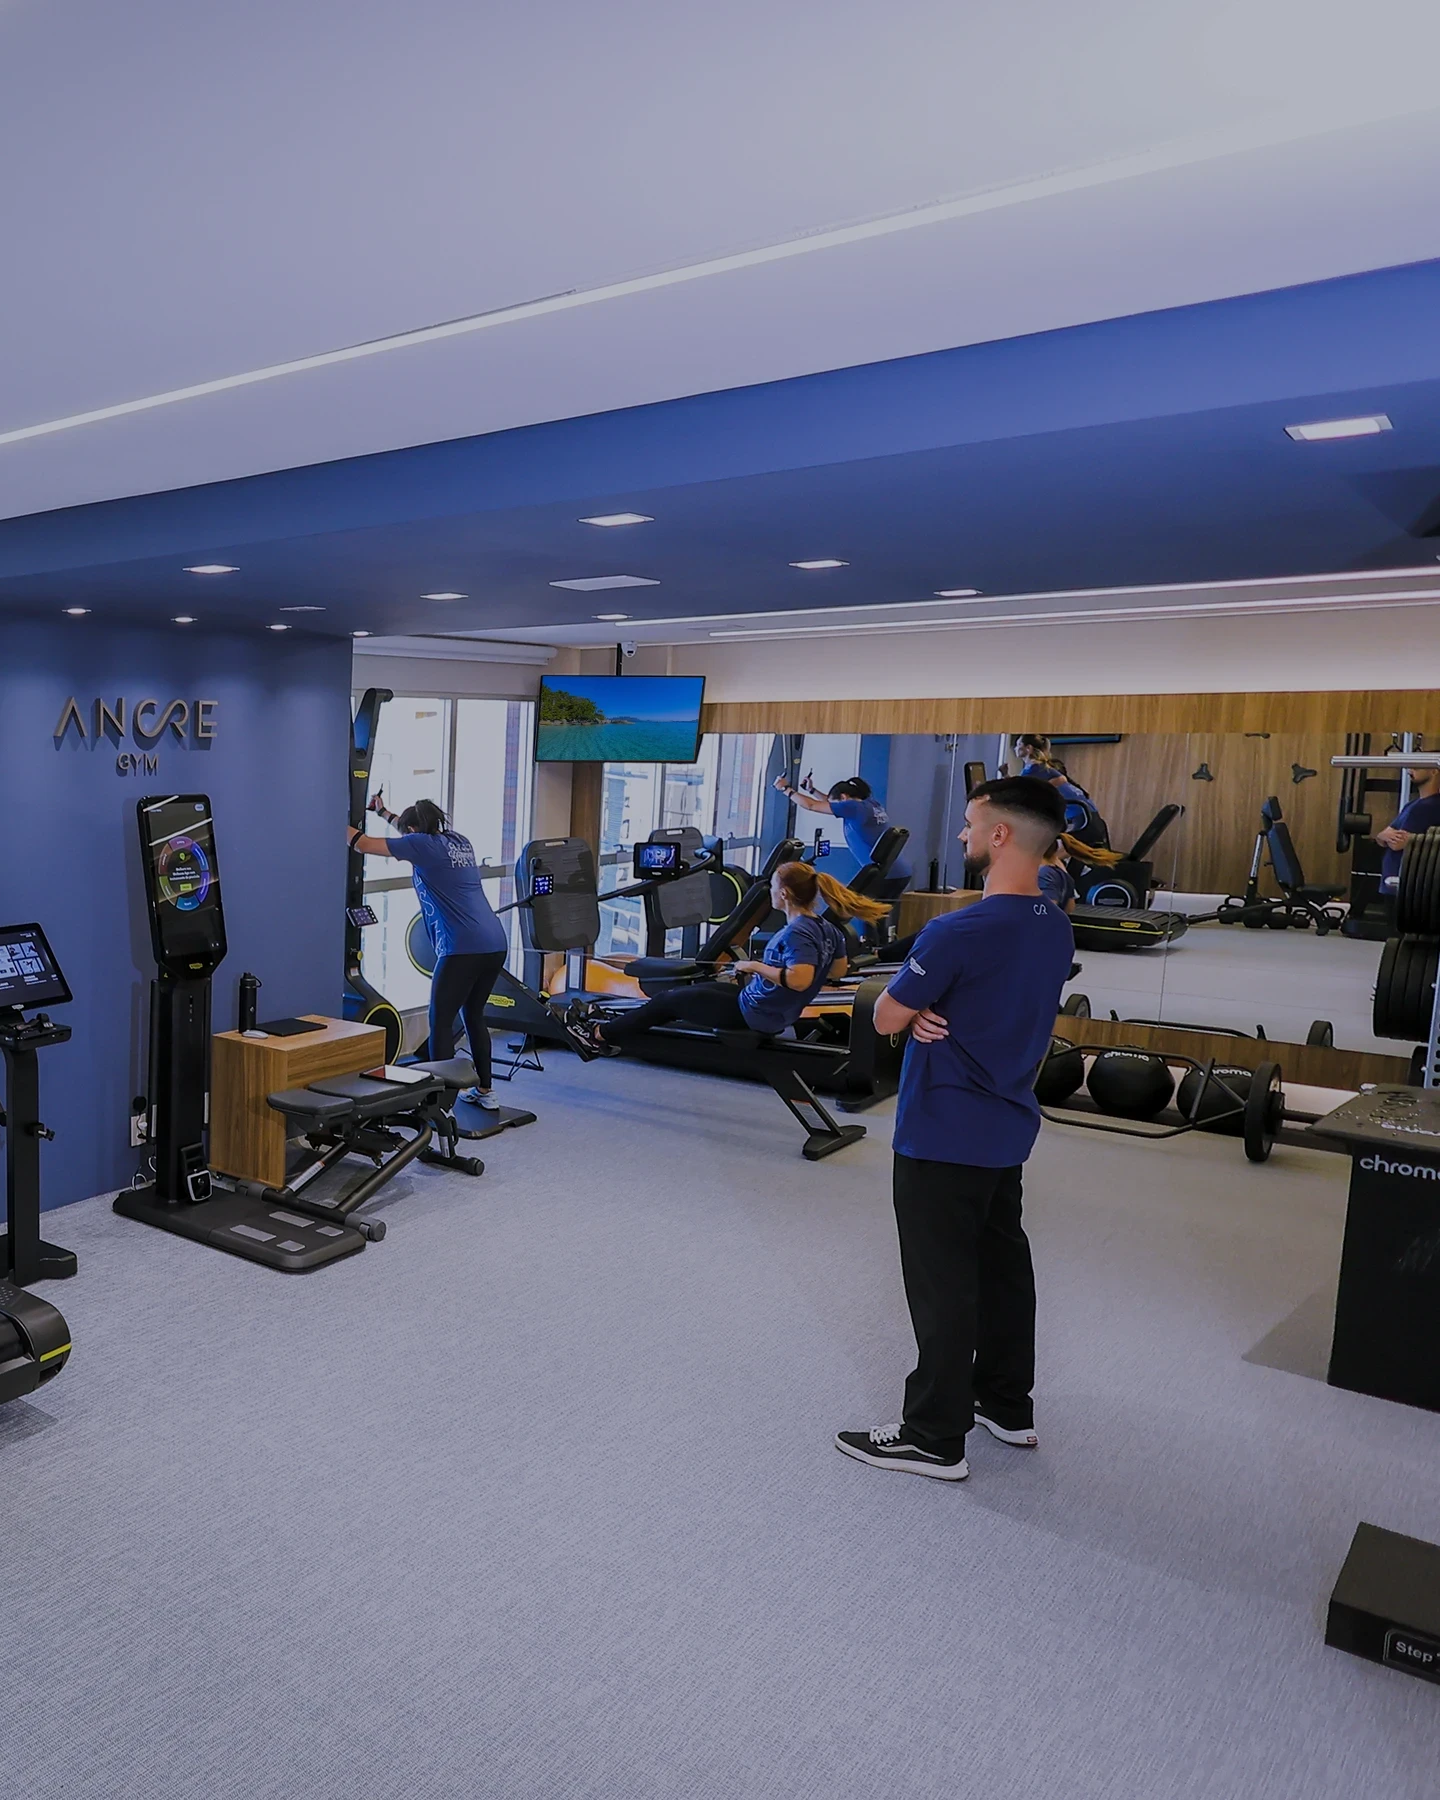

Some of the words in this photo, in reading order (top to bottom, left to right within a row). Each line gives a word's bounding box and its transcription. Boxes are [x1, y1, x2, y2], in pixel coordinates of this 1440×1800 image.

[117, 752, 159, 773] GYM
[1199, 1068, 1252, 1077] croma
[1395, 1641, 1434, 1663] Step
